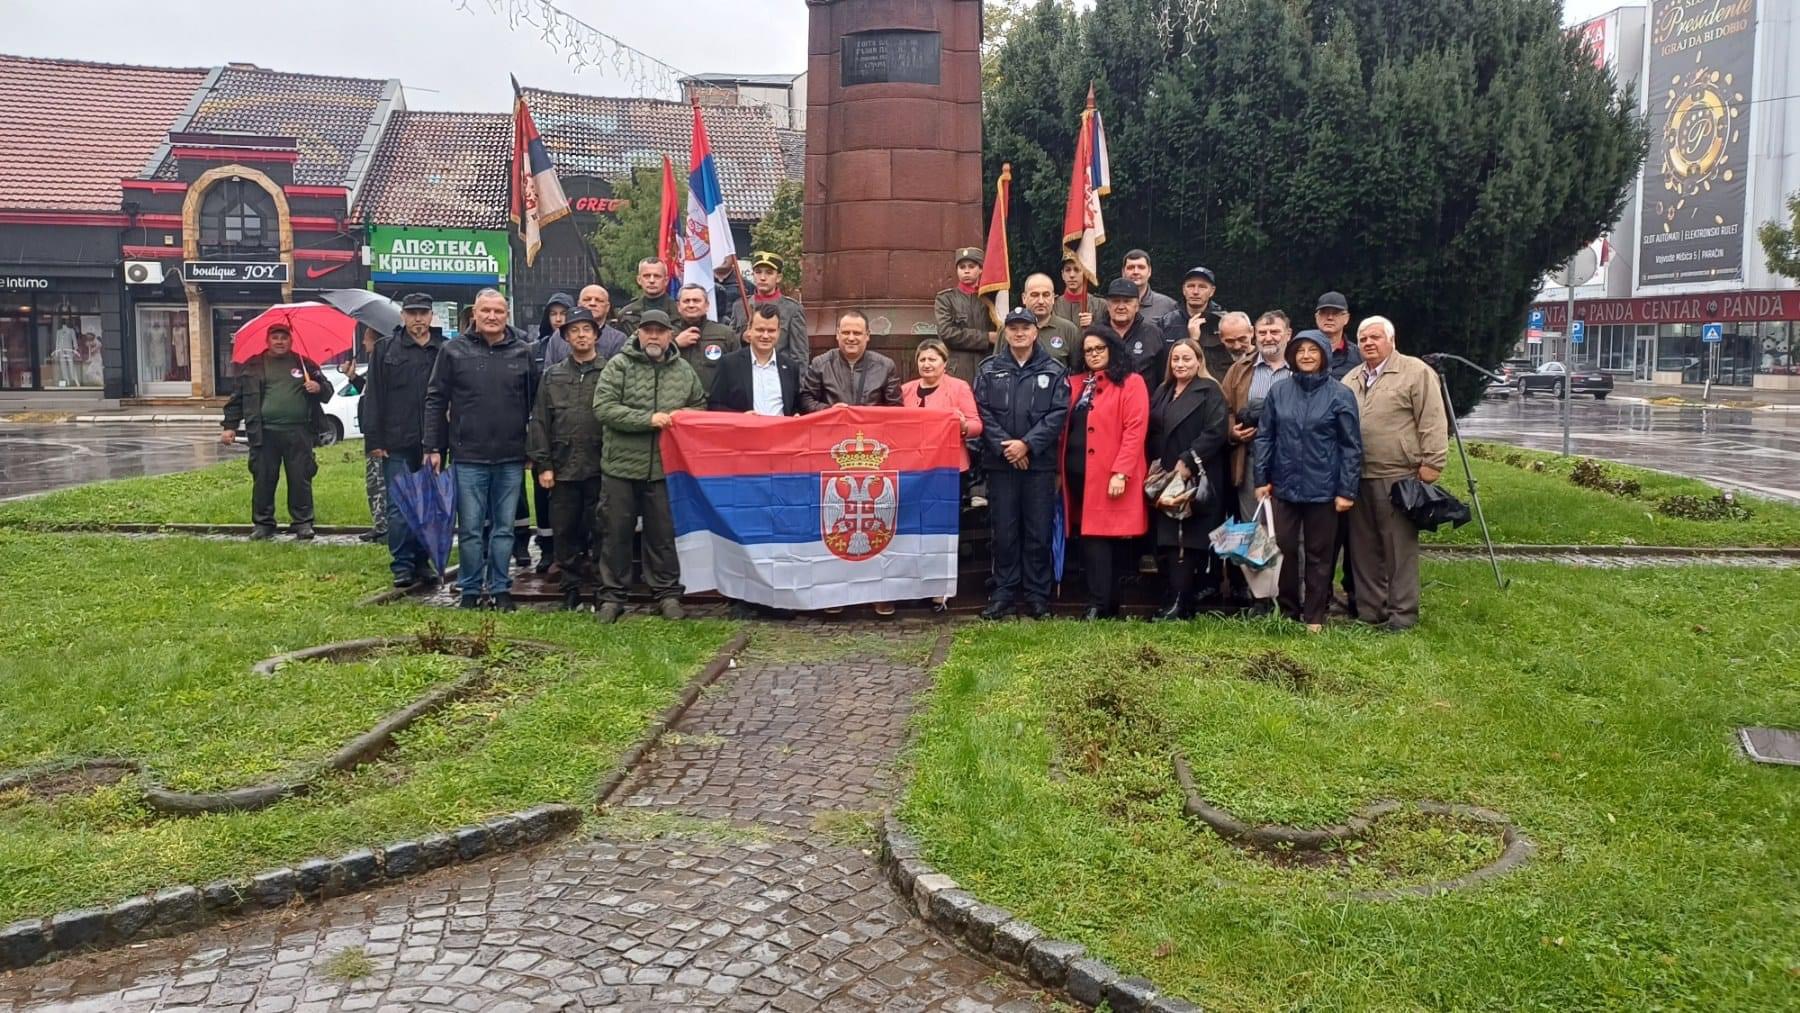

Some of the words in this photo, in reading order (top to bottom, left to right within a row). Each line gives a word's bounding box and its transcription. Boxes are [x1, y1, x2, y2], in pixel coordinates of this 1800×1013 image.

[1661, 0, 1752, 41] Presidente
[1661, 39, 1687, 56] IGRAJ
[1689, 34, 1702, 47] DA
[1704, 30, 1713, 41] BI
[1716, 20, 1748, 38] DOBIO
[391, 239, 488, 256] АПОТЕКА
[192, 264, 237, 280] boutique
[242, 264, 279, 279] JOY
[379, 253, 499, 274] Кршенковић
[1590, 302, 1634, 321] PANDA
[1642, 298, 1701, 320] CENTAR
[1723, 295, 1784, 317] PANDA
